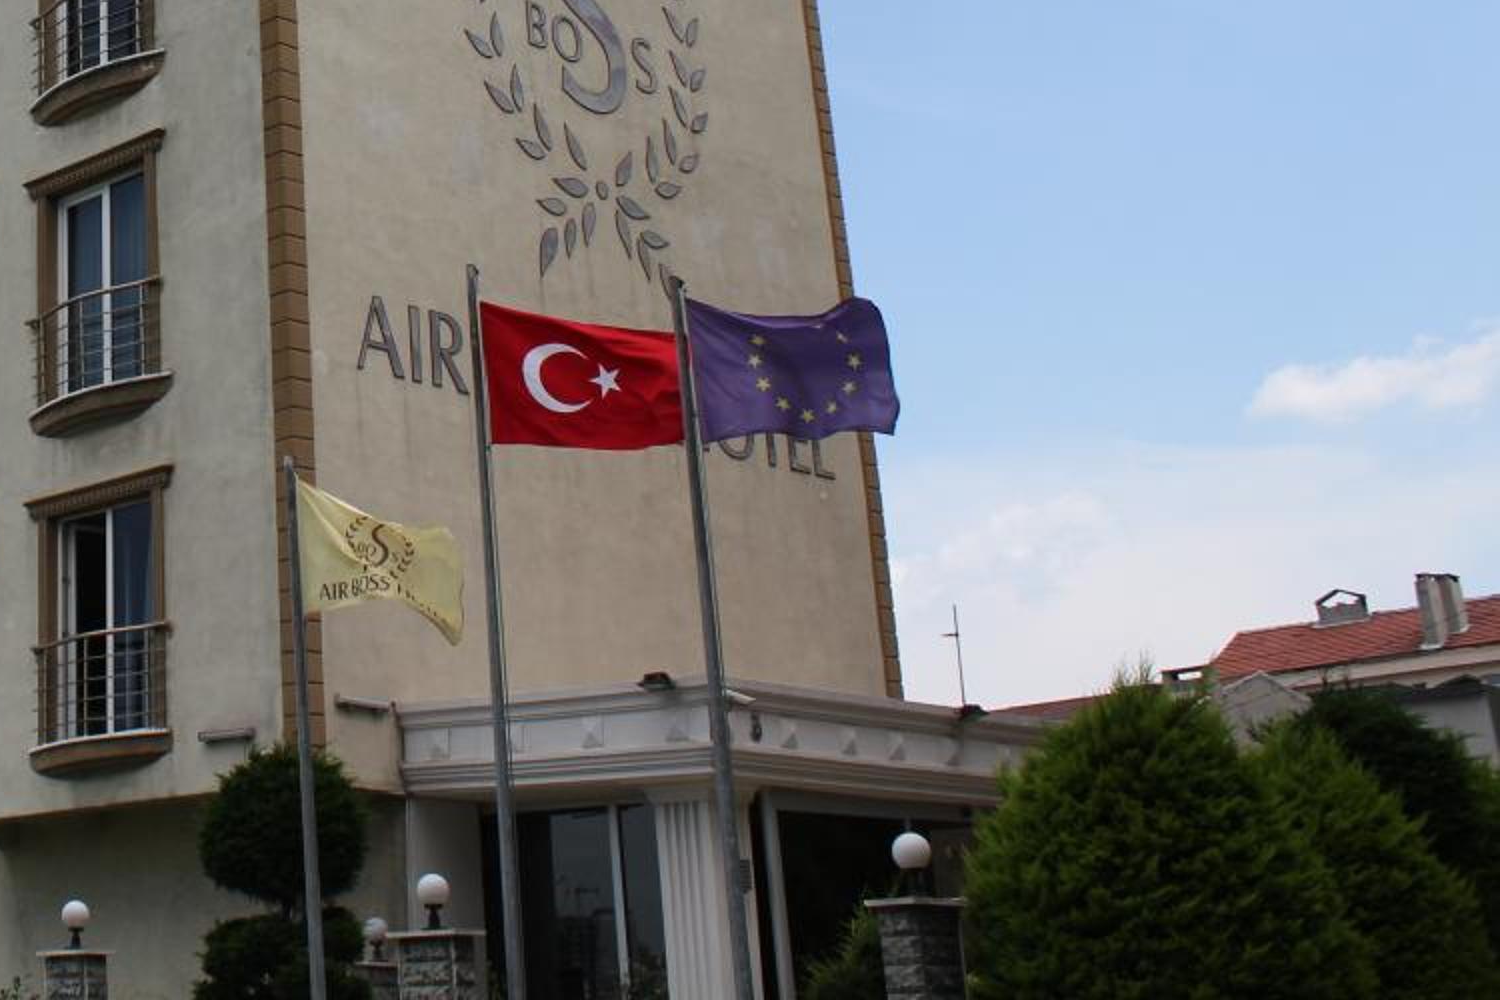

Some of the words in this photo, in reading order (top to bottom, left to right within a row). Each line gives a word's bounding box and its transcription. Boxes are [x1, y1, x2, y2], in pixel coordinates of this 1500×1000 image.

[357, 295, 470, 395] AIR
[319, 582, 349, 601] AIR
[351, 573, 391, 597] BOSS
